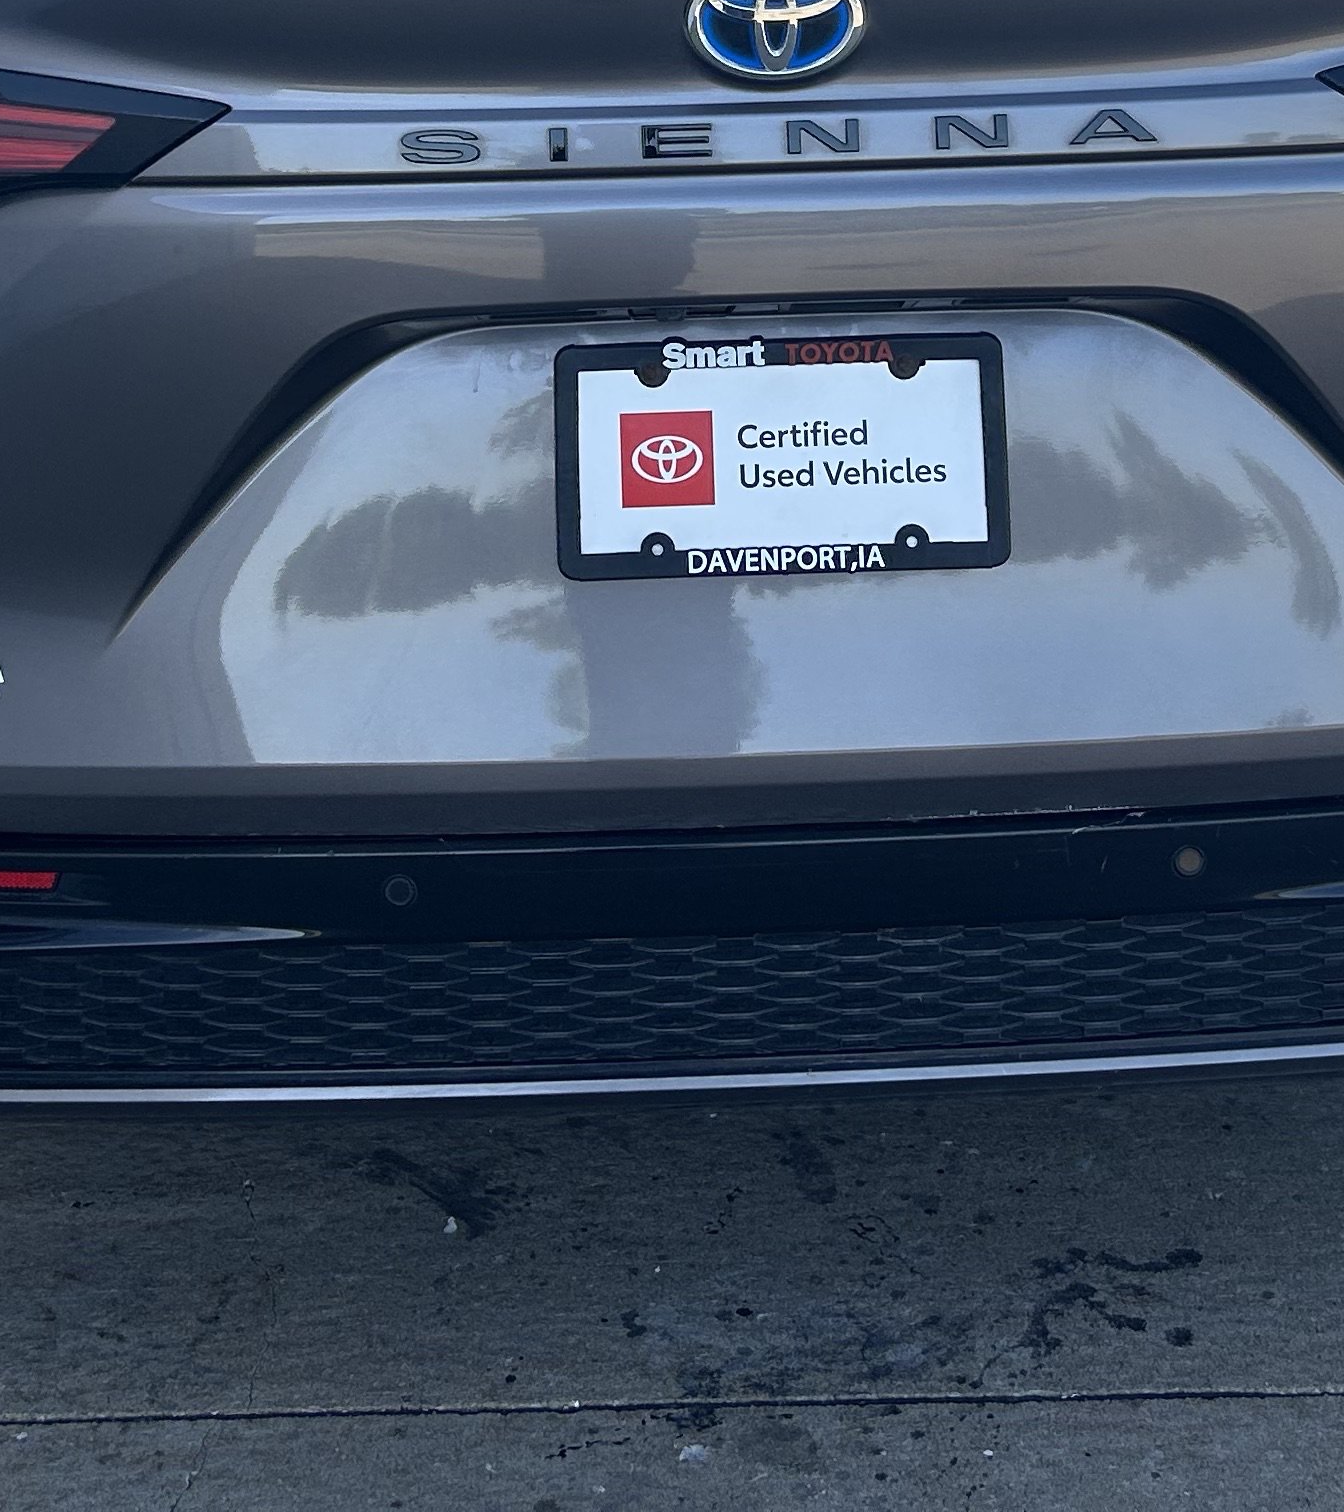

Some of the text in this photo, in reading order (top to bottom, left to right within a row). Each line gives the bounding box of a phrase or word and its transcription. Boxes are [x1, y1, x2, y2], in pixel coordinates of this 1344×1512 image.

[398, 108, 1159, 165] SIENNA
[662, 340, 895, 369] Smart TOYOTA
[737, 419, 869, 449] Certified
[739, 457, 947, 489] Used Vehicles
